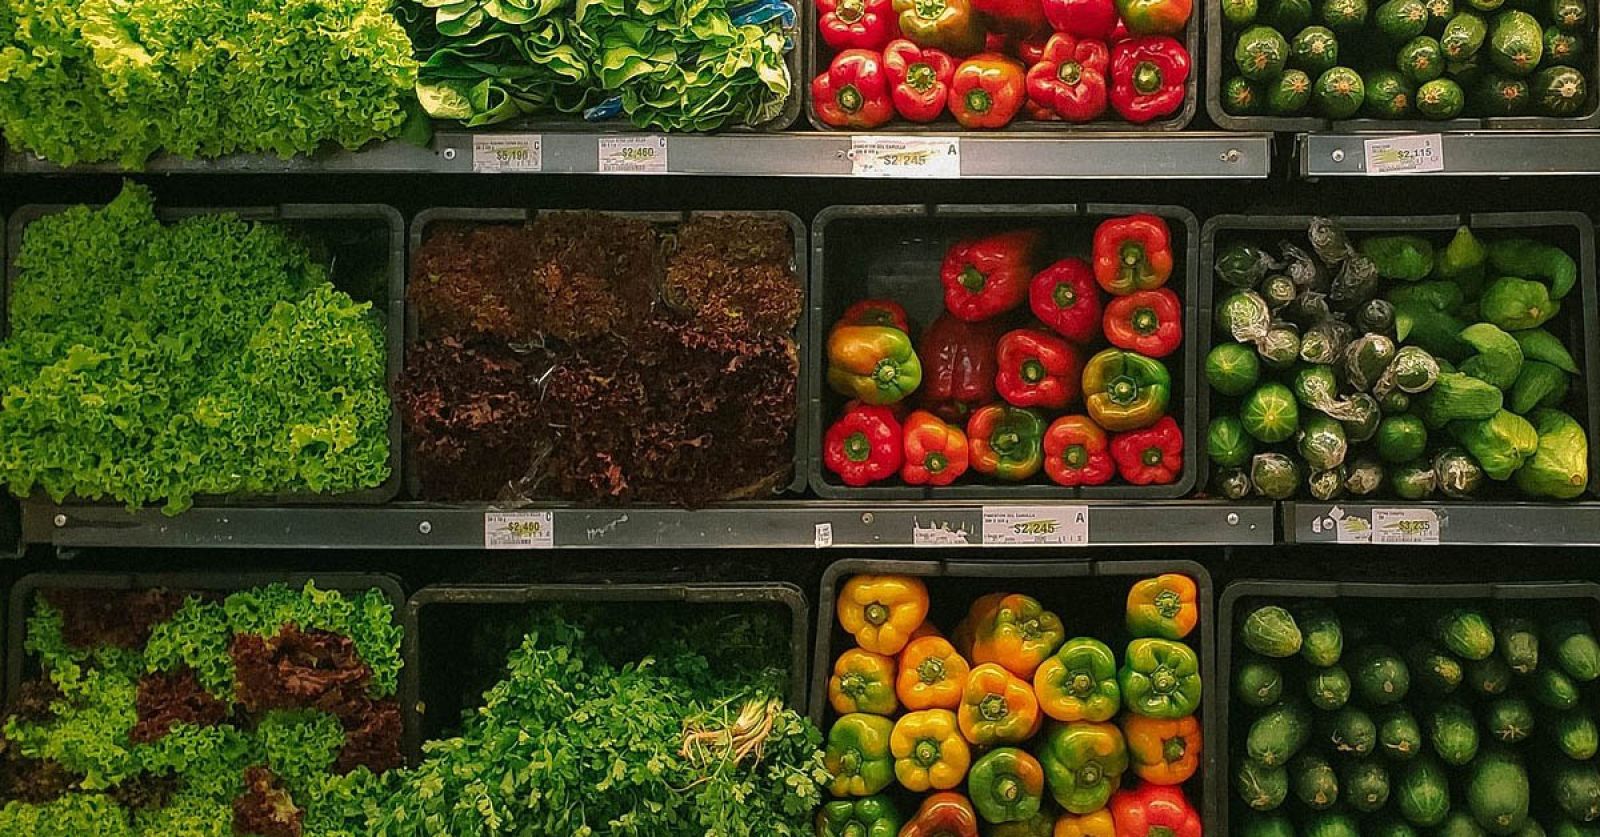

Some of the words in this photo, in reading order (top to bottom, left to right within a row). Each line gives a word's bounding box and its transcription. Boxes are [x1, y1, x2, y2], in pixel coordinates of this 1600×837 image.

[947, 144, 957, 156] A
[1075, 512, 1085, 523] A
[1014, 523, 1055, 535] $2,245
